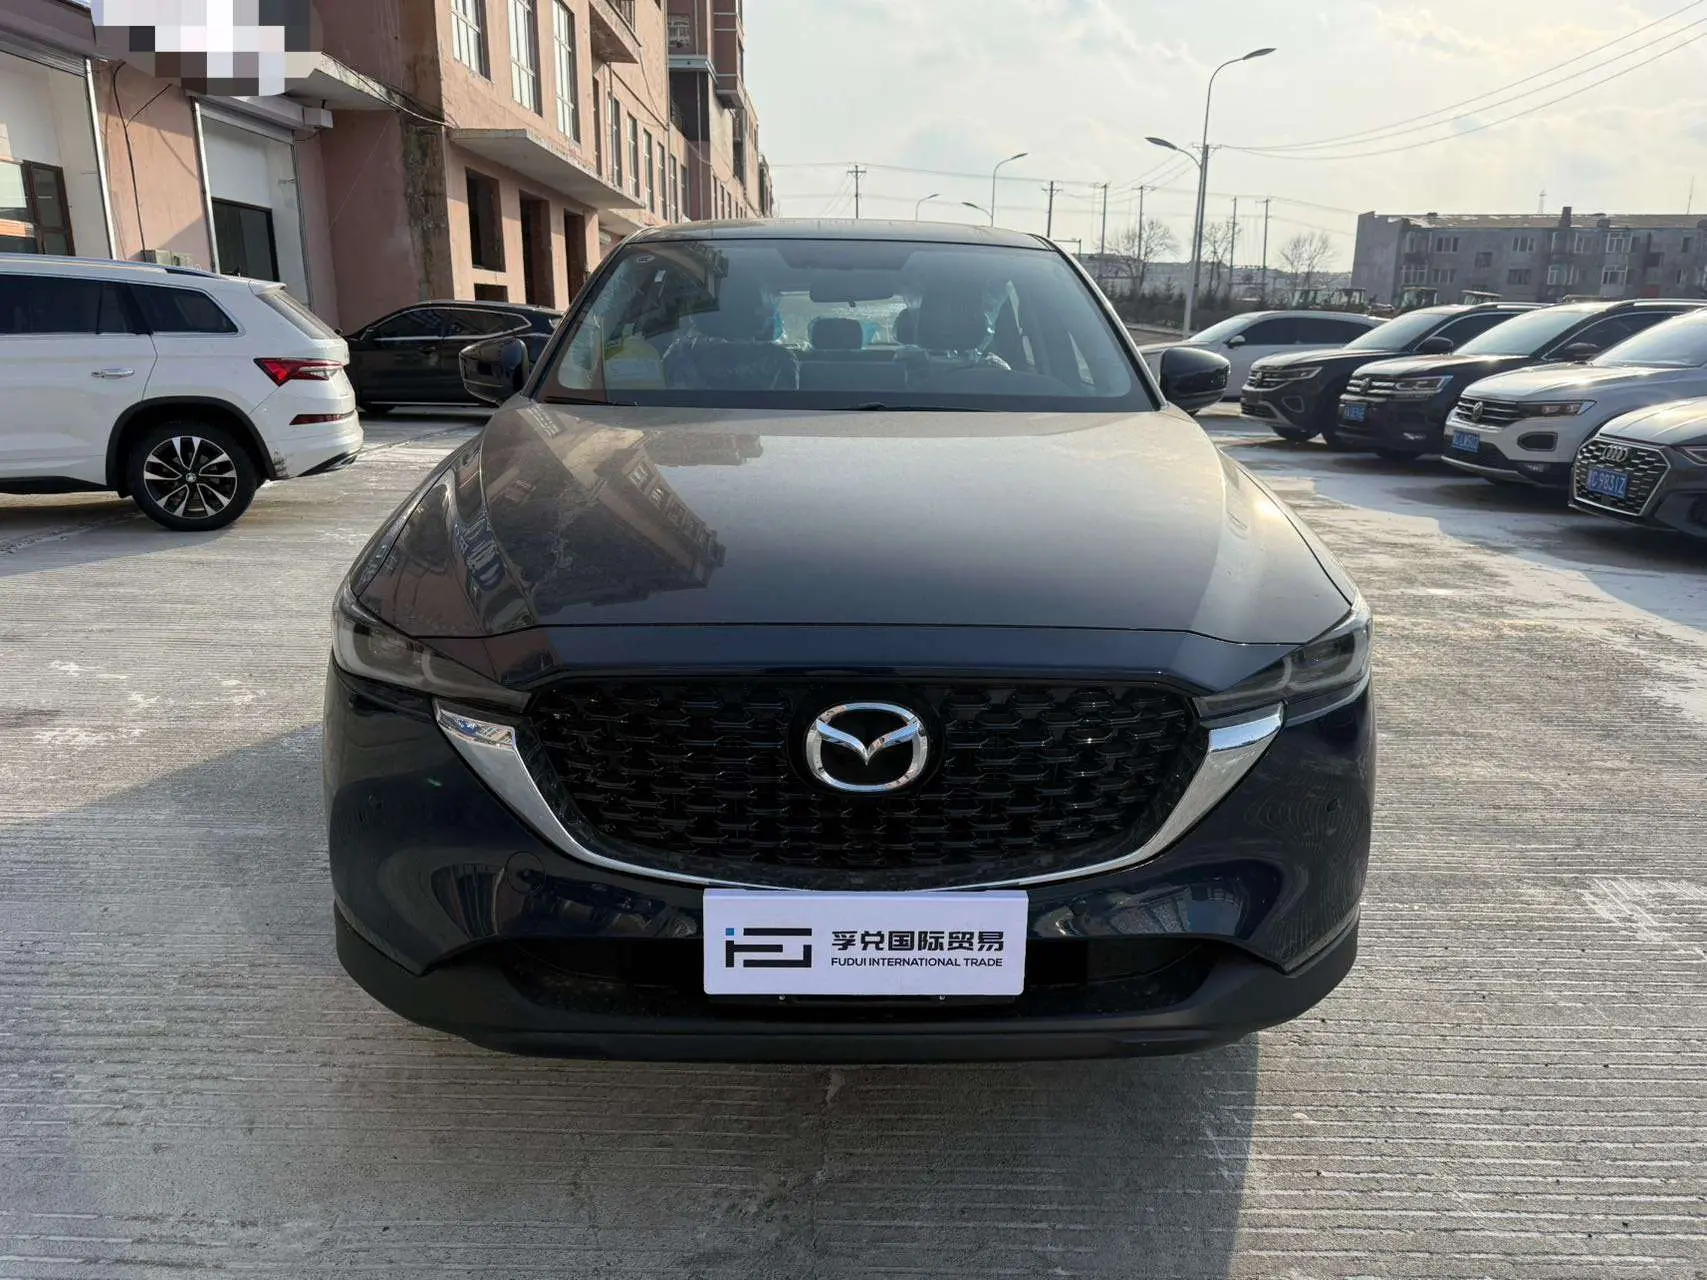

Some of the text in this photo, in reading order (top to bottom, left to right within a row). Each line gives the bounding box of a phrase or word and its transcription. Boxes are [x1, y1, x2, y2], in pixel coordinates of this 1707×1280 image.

[831, 930, 1004, 952] 孚兑国际贸易
[831, 957, 1003, 967] FUDUI INTERNATIONAL TRADE
